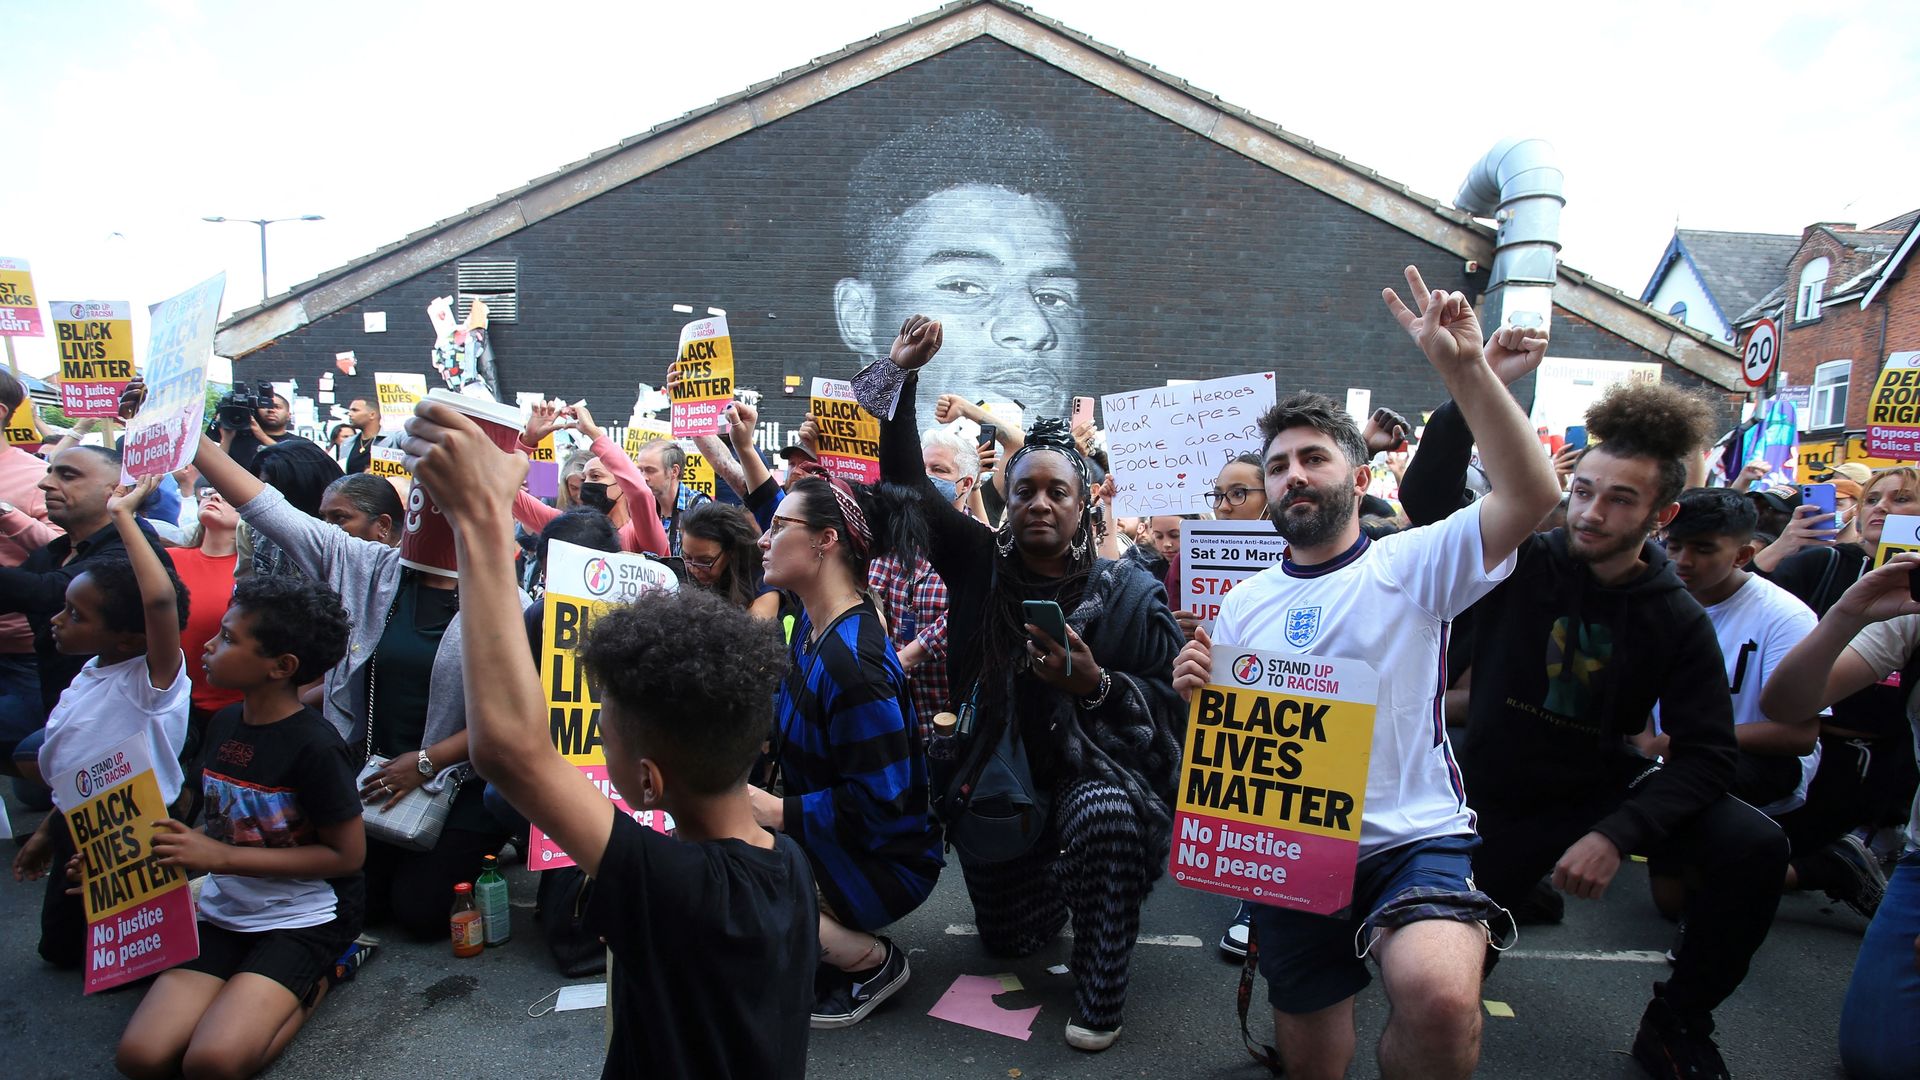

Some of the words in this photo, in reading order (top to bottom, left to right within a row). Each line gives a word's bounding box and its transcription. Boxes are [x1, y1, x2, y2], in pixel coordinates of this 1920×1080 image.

[58, 322, 112, 340] BLACK
[61, 341, 106, 360] LIVES
[678, 340, 717, 362] LACK
[1747, 336, 1772, 369] 20
[65, 384, 82, 396] No
[380, 384, 415, 394] BLAC
[381, 393, 412, 404] LIVES
[673, 377, 731, 399] MATTER
[67, 396, 83, 408] No
[674, 405, 686, 417] No
[687, 403, 717, 417] justice
[813, 400, 861, 421] BLACK
[1105, 395, 1140, 412] NOT
[1150, 392, 1180, 408] ALL
[674, 416, 686, 428] No
[688, 417, 713, 429] peace
[1872, 426, 1919, 440] Oppose
[4, 428, 36, 441] TER
[127, 448, 142, 467] No
[143, 439, 176, 467] peace
[533, 448, 552, 460] TER
[818, 434, 879, 457] MATTER
[1872, 440, 1911, 452] Police
[821, 456, 834, 467] No
[836, 457, 867, 471] justice
[1118, 491, 1206, 514] RASHF
[1191, 547, 1216, 560] Sat
[1221, 548, 1240, 561] 20
[1245, 549, 1283, 562] Marc
[619, 563, 656, 583] STAND
[619, 581, 637, 597] TO
[1191, 577, 1241, 596] STA
[1268, 659, 1311, 676] STAND
[1314, 664, 1334, 678] UP
[1267, 673, 1284, 687] TO
[1287, 675, 1339, 694] RACISM
[1196, 688, 1331, 742] BLACK
[91, 758, 113, 777] STAND
[113, 752, 124, 765] UP
[1191, 728, 1304, 780] LIVES
[93, 777, 105, 789] TO
[104, 762, 132, 785] RACISM
[1185, 768, 1354, 831] MATTER
[71, 784, 142, 844] BLACK
[1180, 817, 1213, 844] No
[1216, 824, 1302, 860] justice
[82, 825, 141, 879] LIVES
[1177, 843, 1210, 869] No
[1214, 855, 1287, 884] peace
[1186, 875, 1250, 892] standuptoracism.org.uk
[1263, 889, 1311, 904] @AntiRacismDay
[93, 923, 115, 948] No
[117, 905, 164, 943] justice
[92, 948, 116, 971] No
[119, 932, 162, 967] peace
